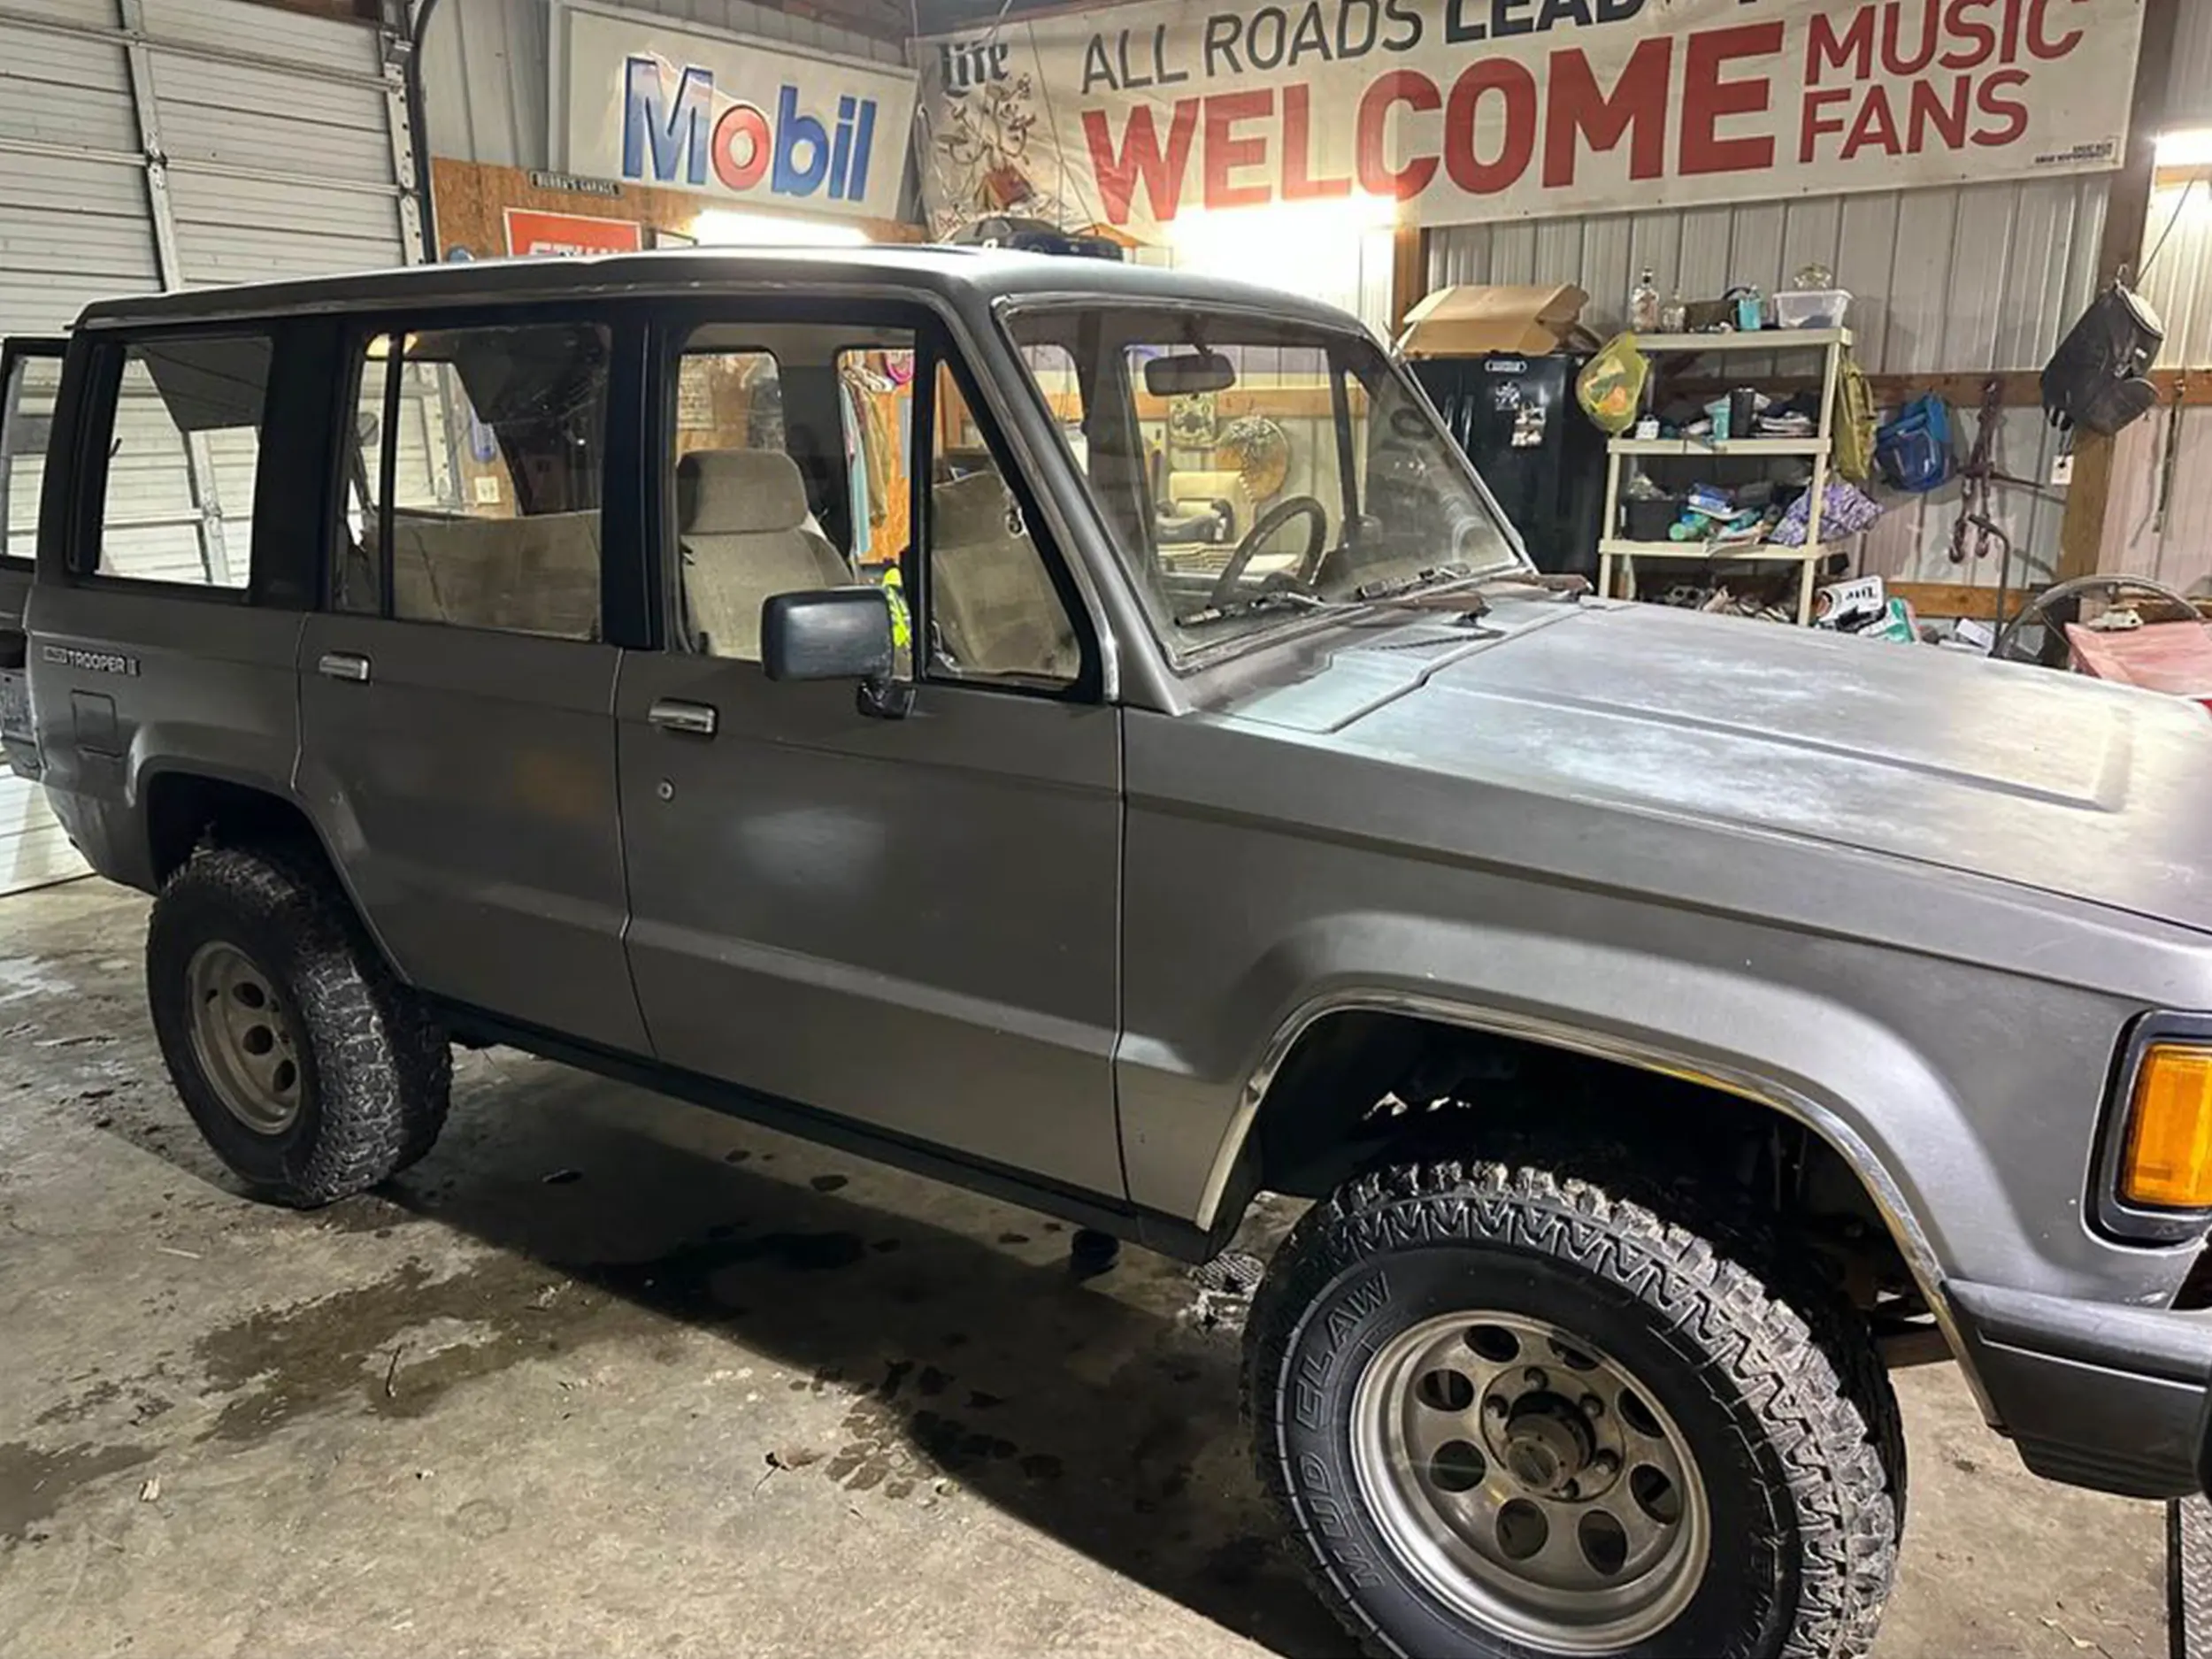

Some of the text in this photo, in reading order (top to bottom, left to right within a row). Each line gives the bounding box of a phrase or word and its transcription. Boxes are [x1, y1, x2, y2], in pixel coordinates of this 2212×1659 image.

[937, 42, 1009, 99] Lite
[1081, 24, 1188, 95] ALL
[1204, 0, 1423, 78] ROADS
[1804, 0, 2085, 86] MUSIC
[622, 56, 878, 202] Mobil
[1080, 20, 1786, 226] WELCOME
[1799, 69, 2032, 164] FANS
[68, 649, 127, 676] TROOPER
[1294, 1269, 1392, 1590] MUD CLAW
